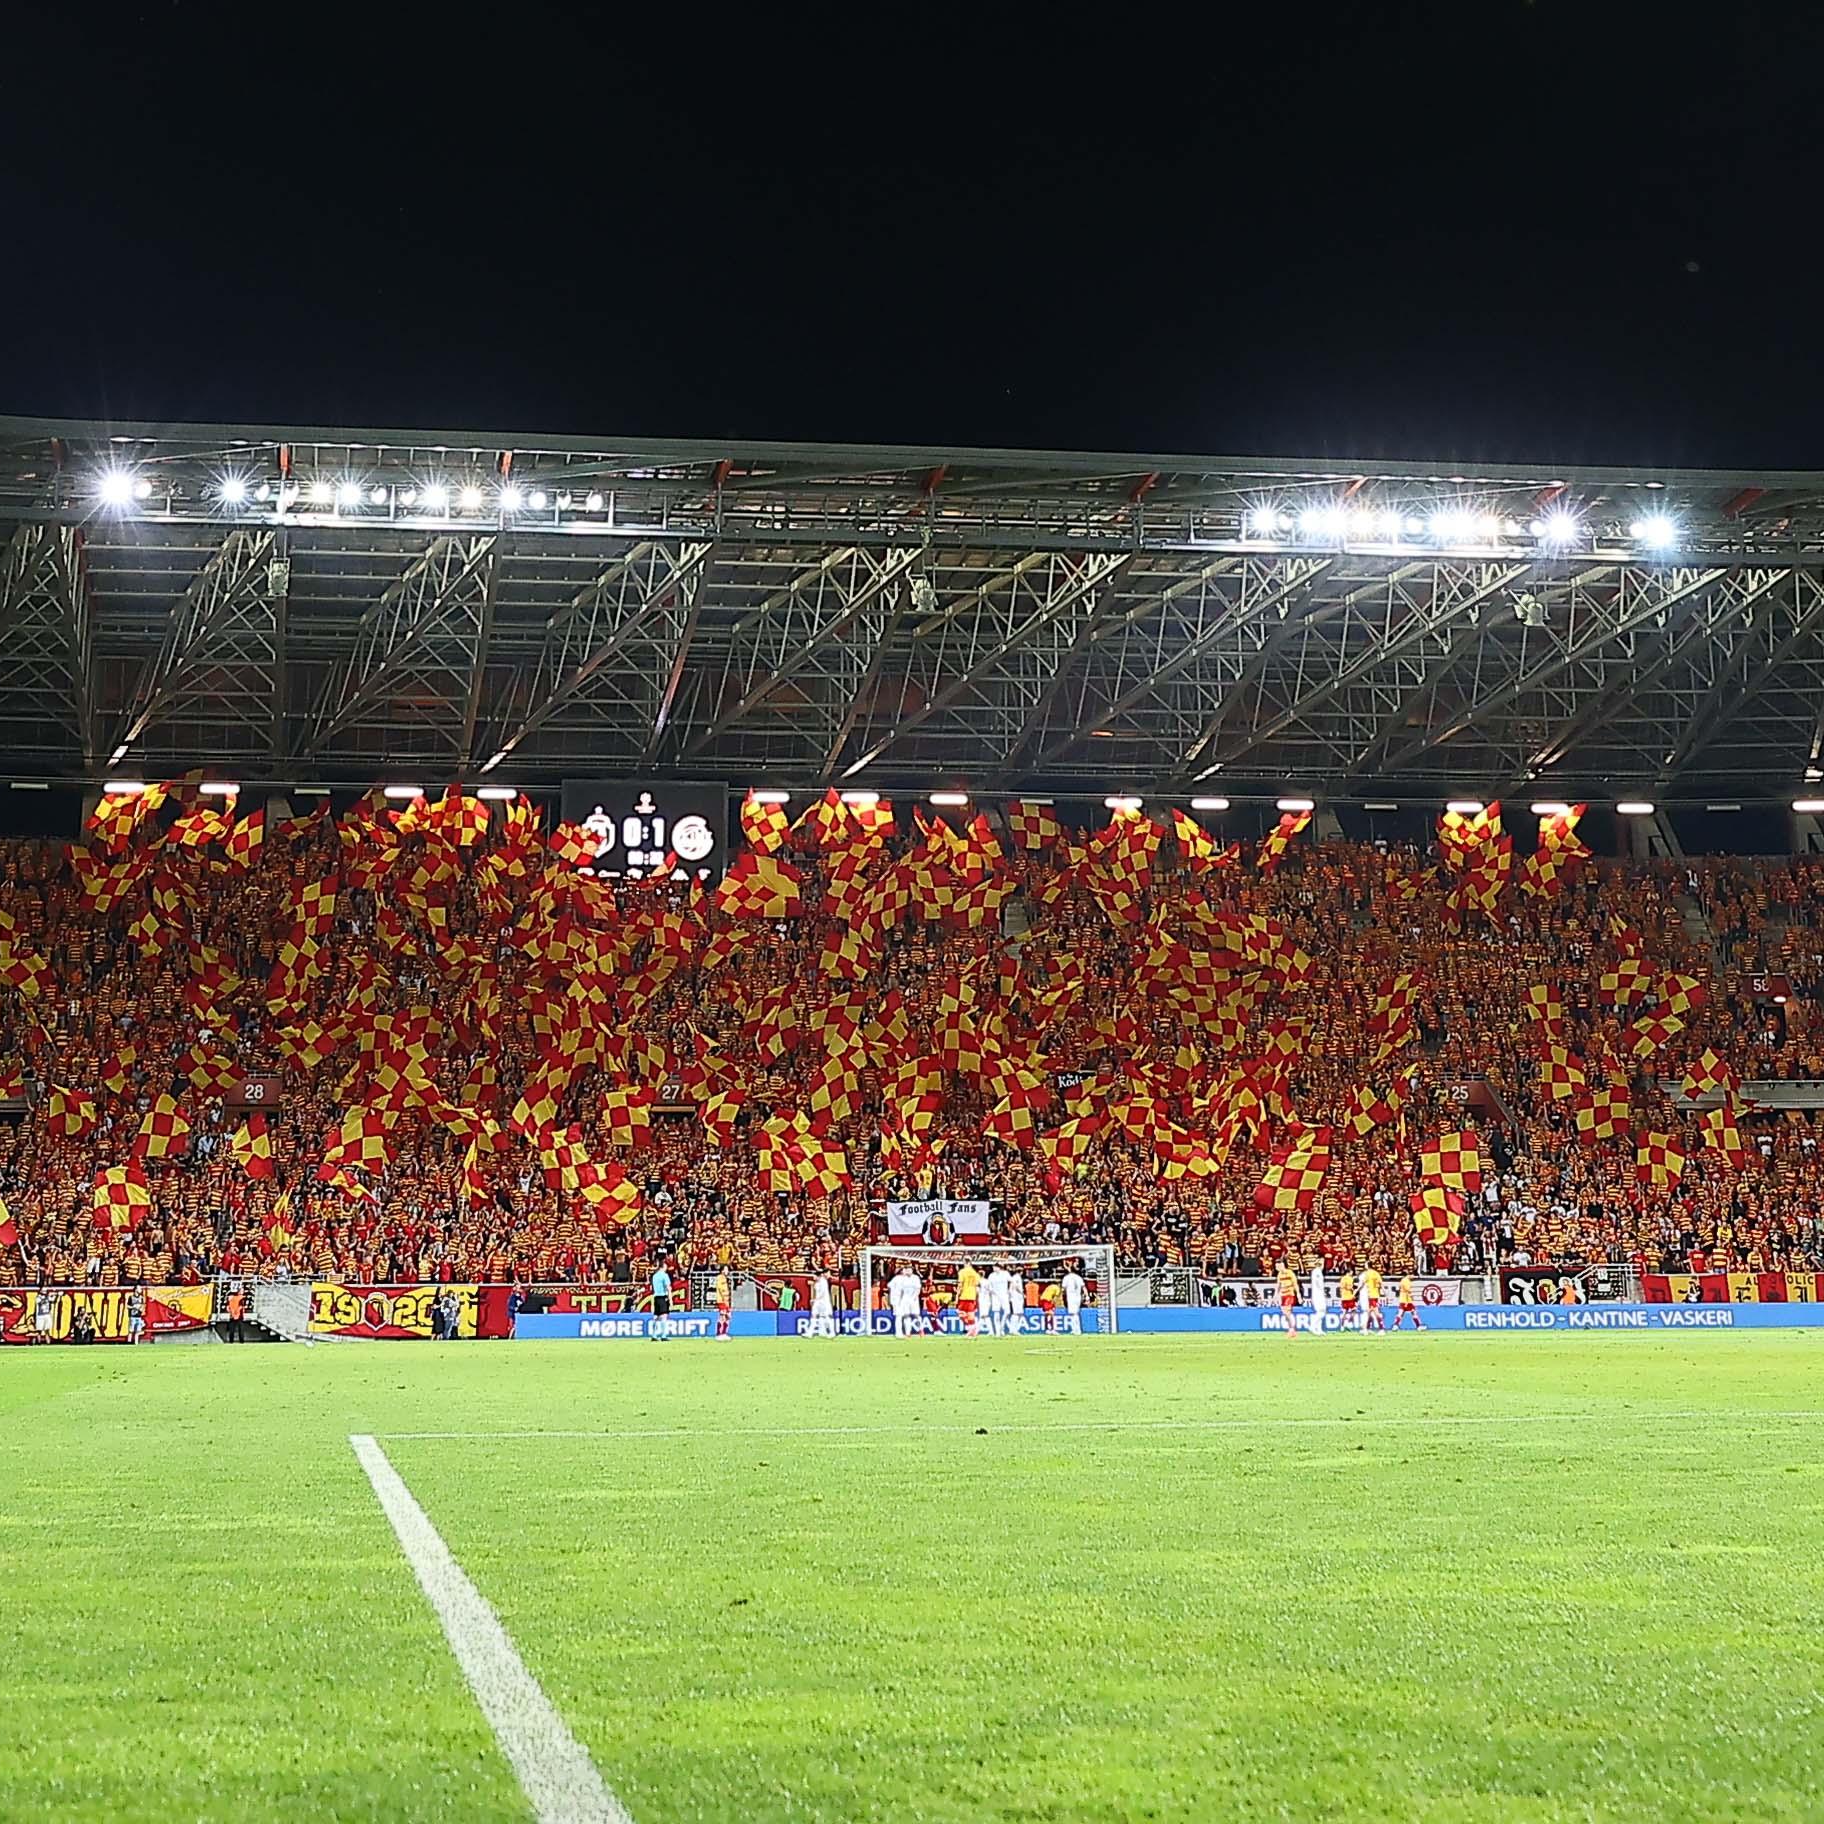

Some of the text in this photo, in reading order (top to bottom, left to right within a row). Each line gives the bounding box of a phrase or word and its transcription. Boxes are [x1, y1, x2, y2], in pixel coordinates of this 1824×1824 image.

[244, 1084, 264, 1099] 28
[662, 1084, 680, 1100] 27
[1451, 1085, 1469, 1100] 25
[899, 1200, 977, 1216] Football Fans
[1464, 1311, 1555, 1327] RENHOLD
[1568, 1310, 1648, 1326] KANTINE
[1659, 1309, 1734, 1326] VASKERI
[580, 1319, 643, 1337] MØRE
